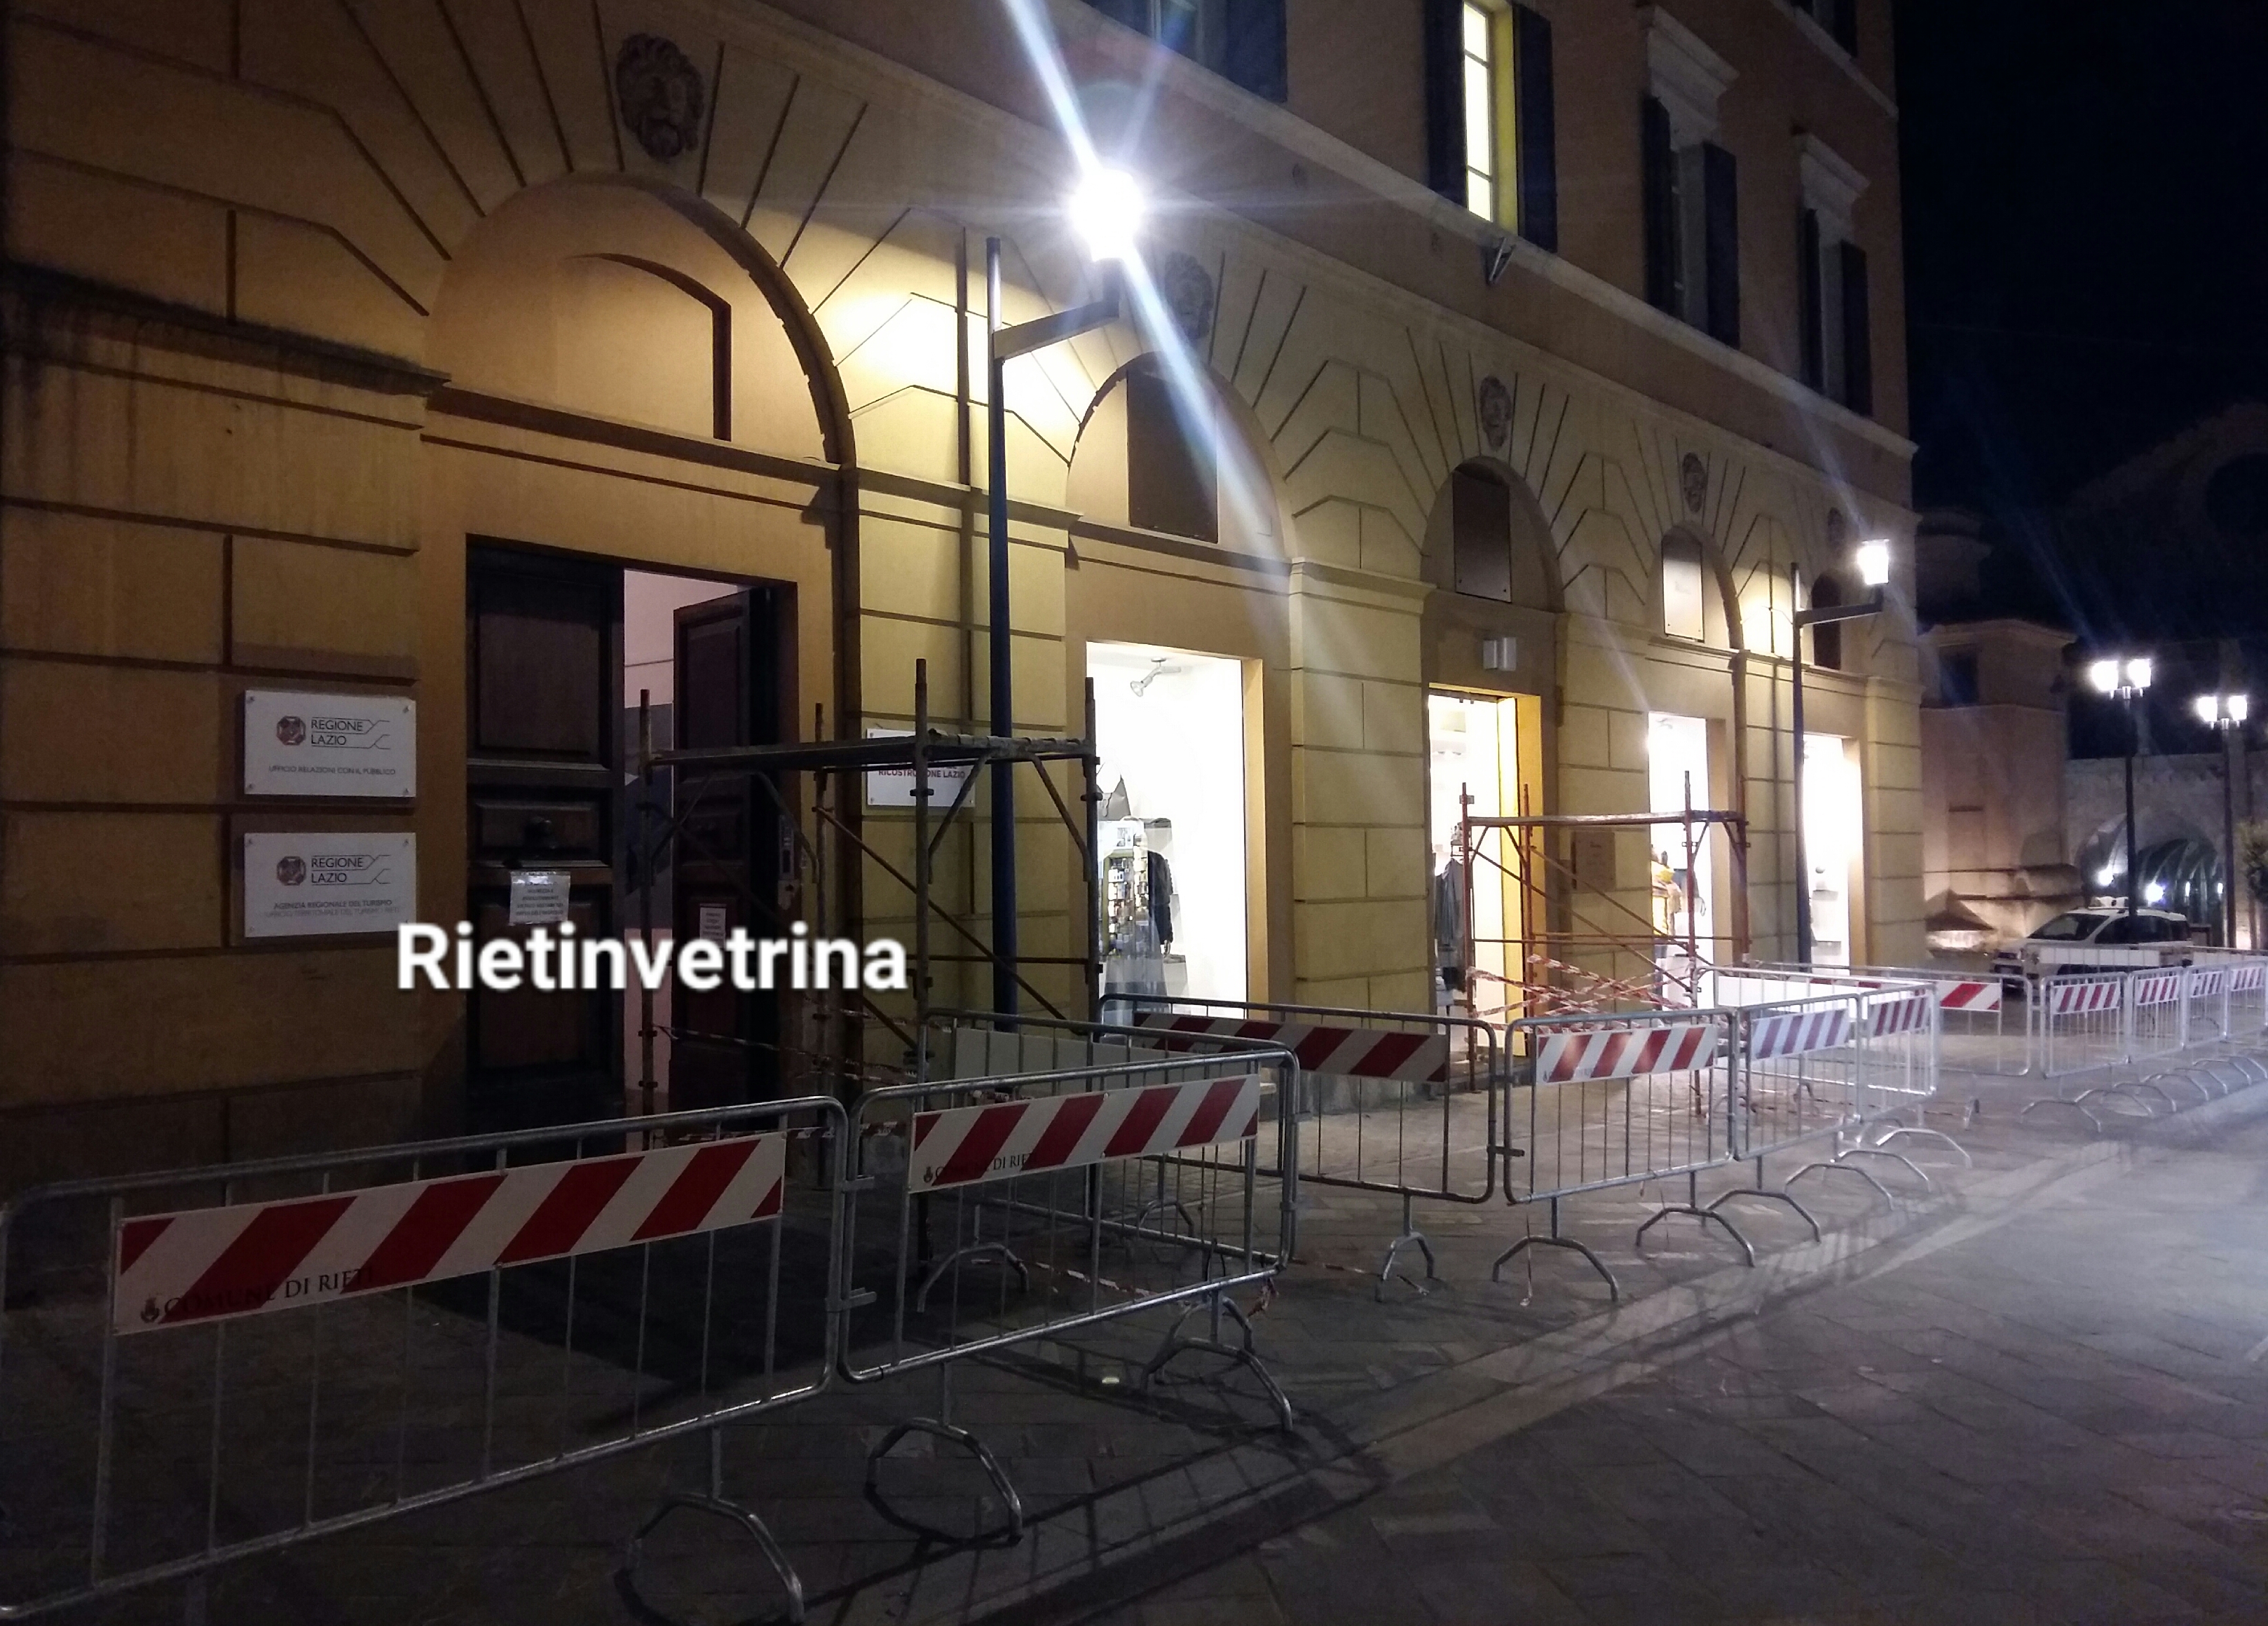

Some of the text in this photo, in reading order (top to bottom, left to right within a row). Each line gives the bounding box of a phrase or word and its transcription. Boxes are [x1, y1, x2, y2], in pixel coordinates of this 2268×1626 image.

[311, 720, 363, 732] REGIONE
[311, 734, 347, 746] LAZIO
[298, 766, 336, 774] RELAZIONI
[878, 770, 966, 779] RICOSTRUONE LAZIO
[311, 857, 364, 868] REGIONE
[311, 872, 347, 883] LAZIO
[273, 901, 306, 910] AGENZIA
[307, 901, 347, 909] REGIONALE
[993, 1156, 1006, 1170] DI
[165, 1266, 373, 1316] COMUNE DI RIETI
